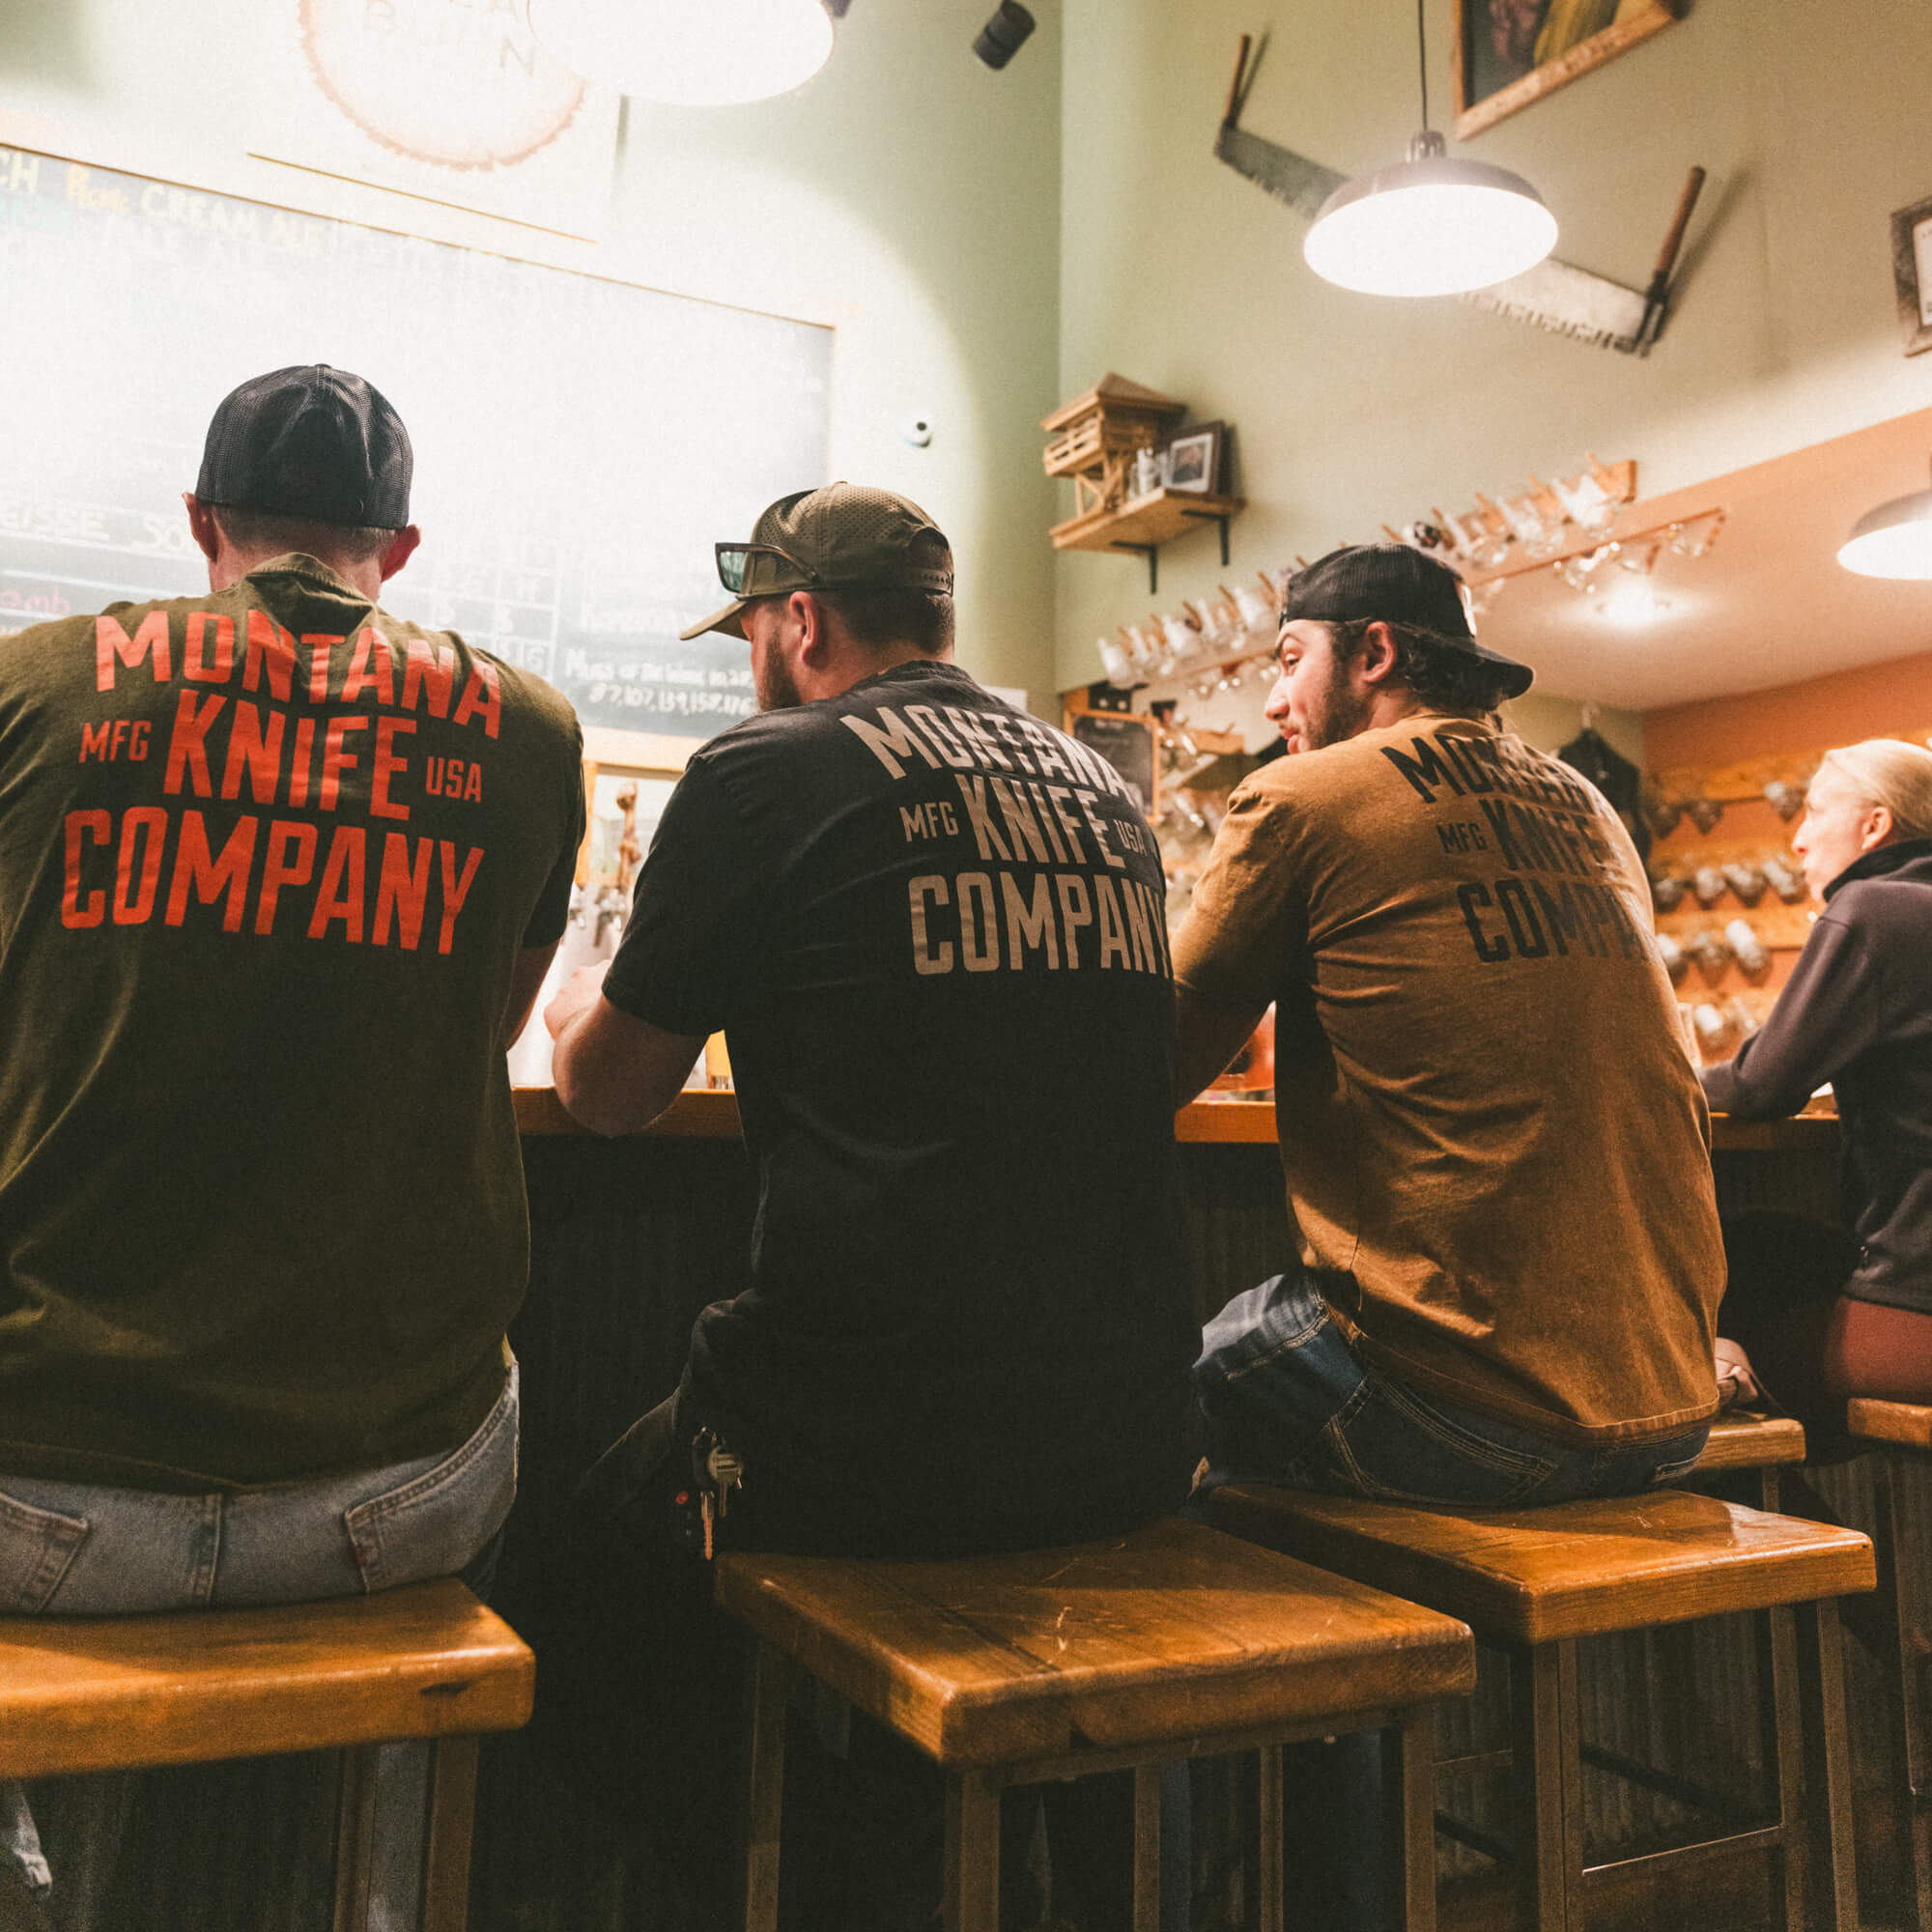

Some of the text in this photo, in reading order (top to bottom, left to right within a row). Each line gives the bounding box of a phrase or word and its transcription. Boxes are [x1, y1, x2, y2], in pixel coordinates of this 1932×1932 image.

[97, 610, 501, 740] MONTANA
[78, 689, 483, 821] MFG KNIFE USA
[61, 806, 485, 955] COMPANY
[898, 774, 1149, 868] MFG KNIFE USA
[1436, 799, 1611, 877] MFG KNIFE
[908, 871, 1170, 980] COMPANY
